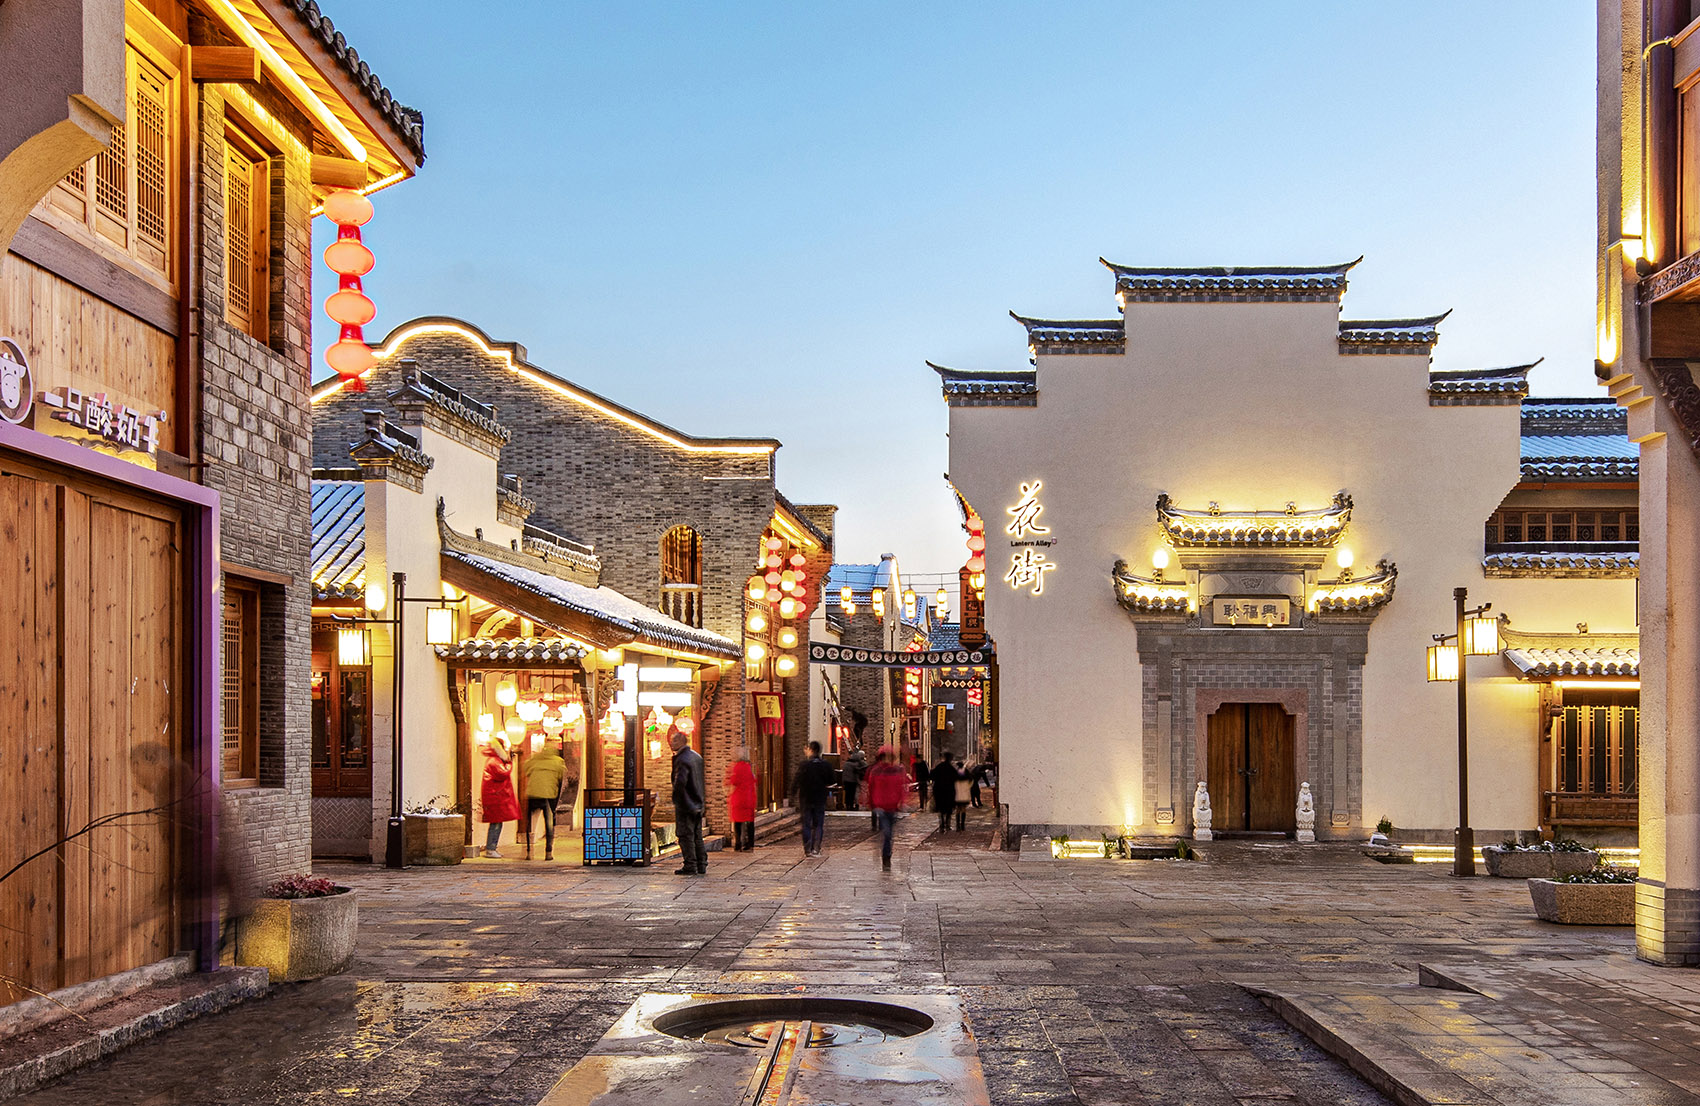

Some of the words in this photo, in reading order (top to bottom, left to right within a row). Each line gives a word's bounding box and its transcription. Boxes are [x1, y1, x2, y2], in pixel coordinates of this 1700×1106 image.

[43, 387, 159, 453] 一只酸奶牛
[1035, 540, 1052, 548] Alley
